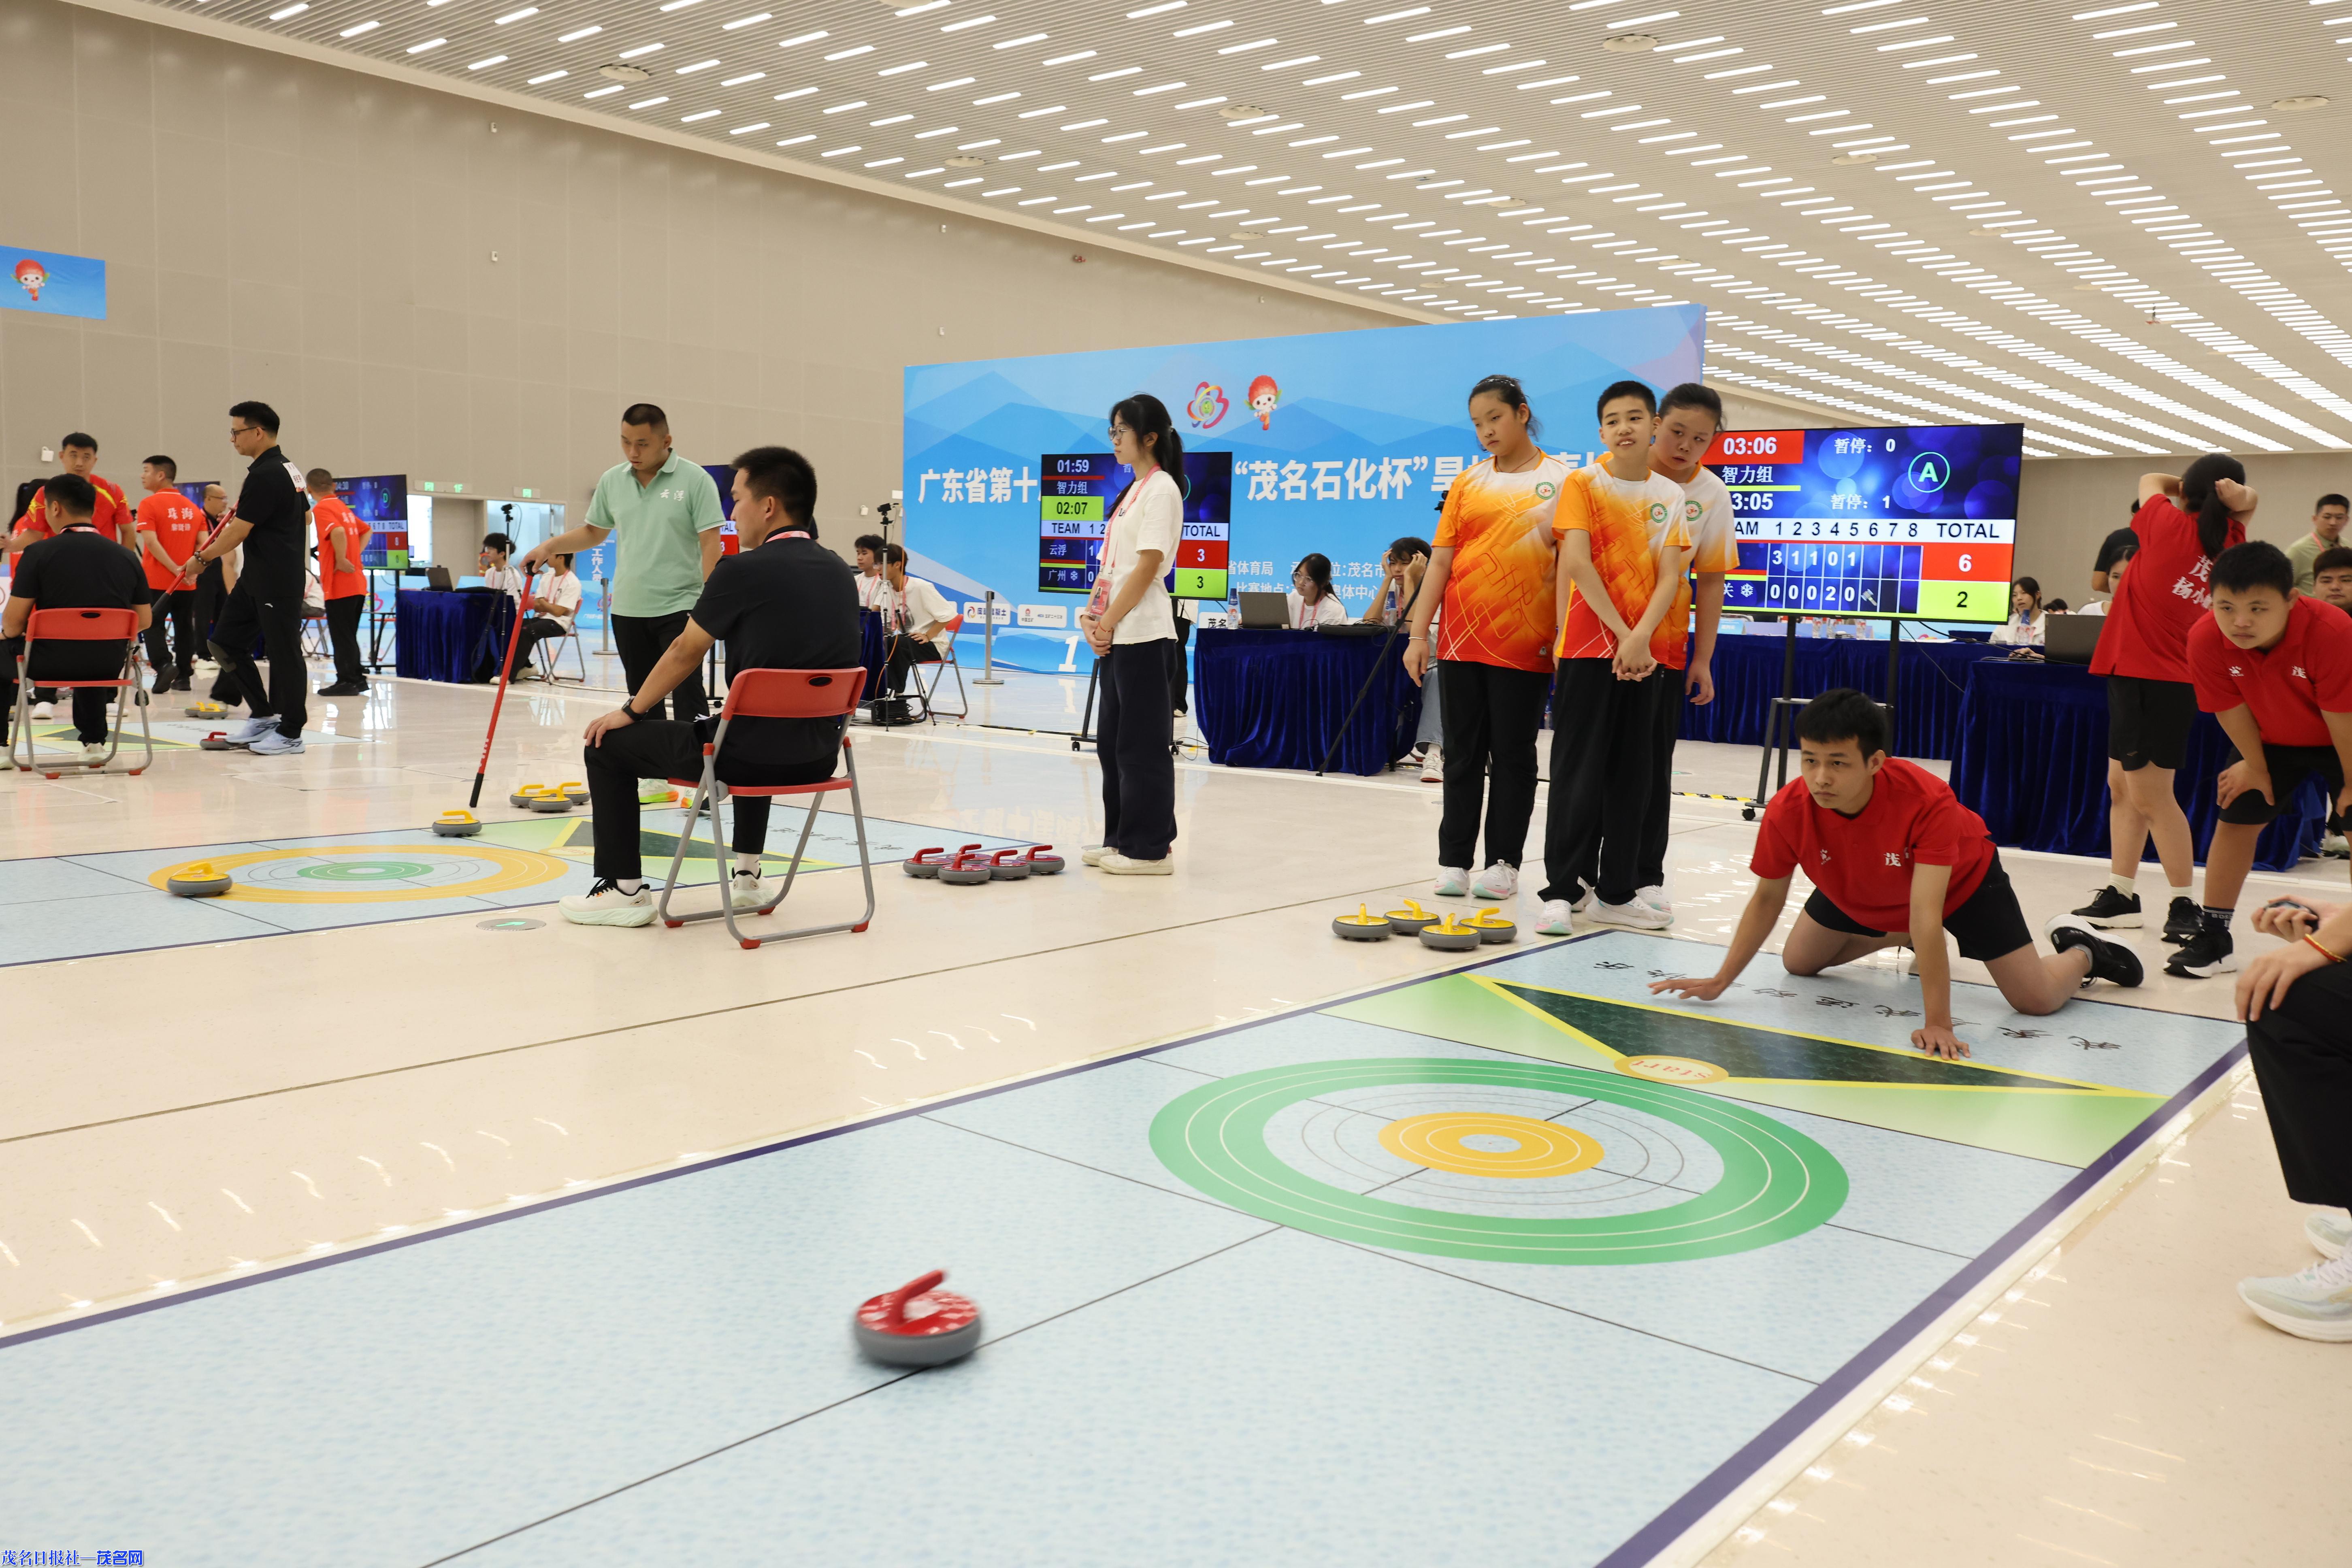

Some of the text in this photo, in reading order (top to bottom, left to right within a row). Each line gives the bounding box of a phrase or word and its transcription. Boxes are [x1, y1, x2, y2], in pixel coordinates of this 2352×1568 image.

[1723, 437, 1777, 455] 03:06
[1834, 438, 1896, 454] 暂停： 0
[1057, 459, 1089, 473] 01:59
[1918, 462, 1939, 482] A
[1721, 465, 1774, 484] 智力组
[918, 466, 1041, 503] 广东省第十
[1056, 481, 1088, 494] 智力组
[660, 489, 684, 501] 云浮
[1731, 492, 1774, 511] 3:05
[1830, 494, 1890, 510] 暂停： 1
[1057, 502, 1088, 515] 02:07
[1052, 523, 1080, 534] TEAM
[1089, 524, 1094, 534] 1
[1100, 524, 1105, 534] 2
[1183, 525, 1221, 537] TOTAL
[1735, 521, 1999, 538] AM 1 2 3 4 5 6 7 8 TOTAL
[1049, 544, 1094, 556] 云浮 1
[1197, 548, 1206, 562] 3
[1772, 550, 1856, 566] 3 1 1 0 1
[592, 548, 604, 581] 工作人员
[1228, 560, 1273, 576] 省体育局
[1958, 554, 1972, 572] 6
[1048, 570, 1094, 582] 广州 0
[1197, 576, 1204, 589] 3
[1770, 584, 1781, 599] 0
[1788, 584, 1799, 600] 0
[1807, 585, 1817, 601] 0
[1825, 586, 1836, 601] 2
[1844, 587, 1855, 602] 0
[1956, 591, 1967, 608] 2
[1058, 635, 1080, 673] 1
[1631, 1060, 1711, 1079] start
